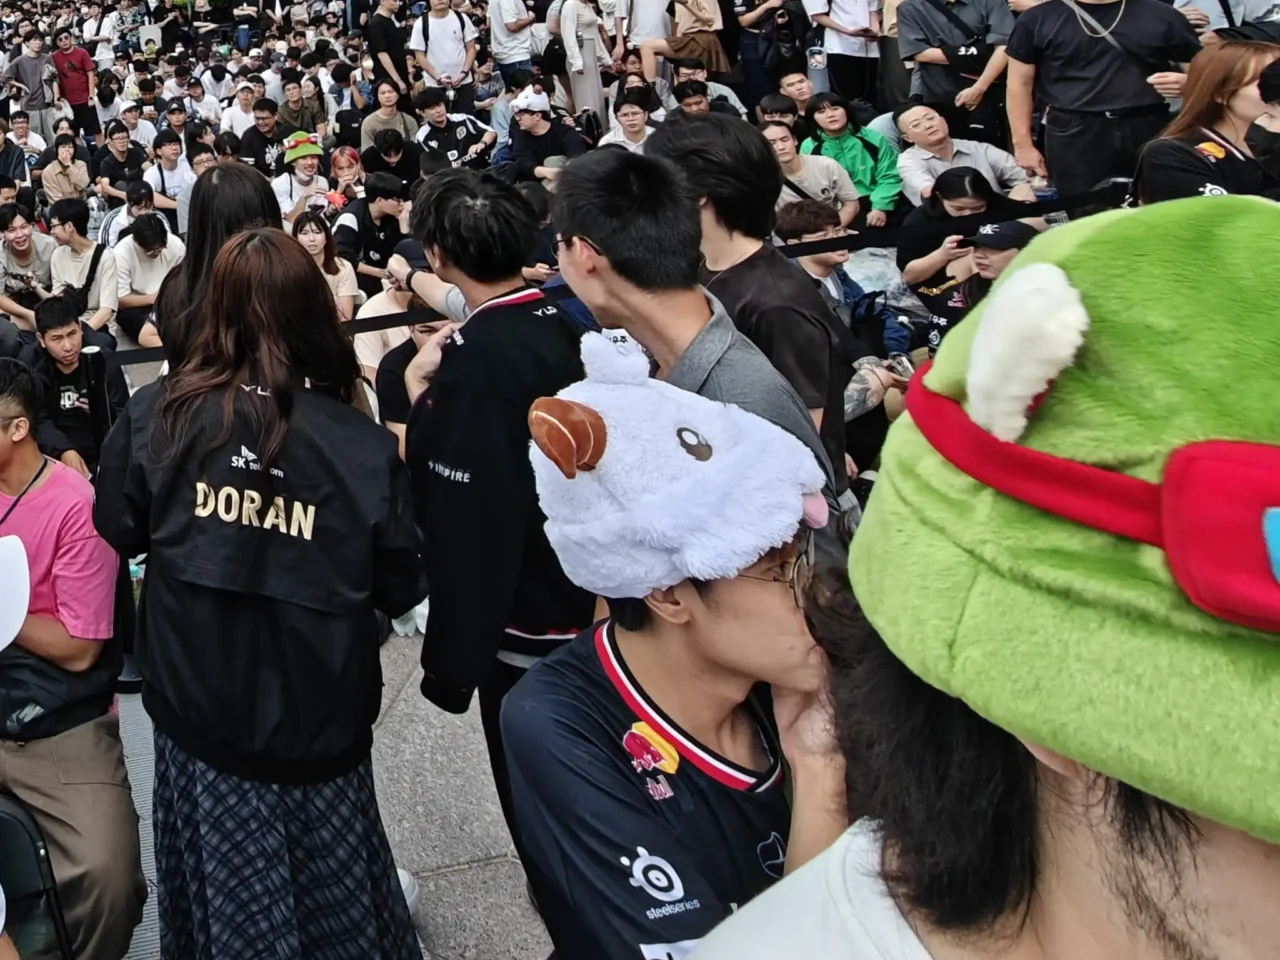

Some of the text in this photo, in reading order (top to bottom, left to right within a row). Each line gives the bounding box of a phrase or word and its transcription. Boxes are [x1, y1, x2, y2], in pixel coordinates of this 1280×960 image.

[230, 455, 247, 470] SK
[194, 482, 317, 541] DORAN
[645, 898, 702, 920] steelseries
